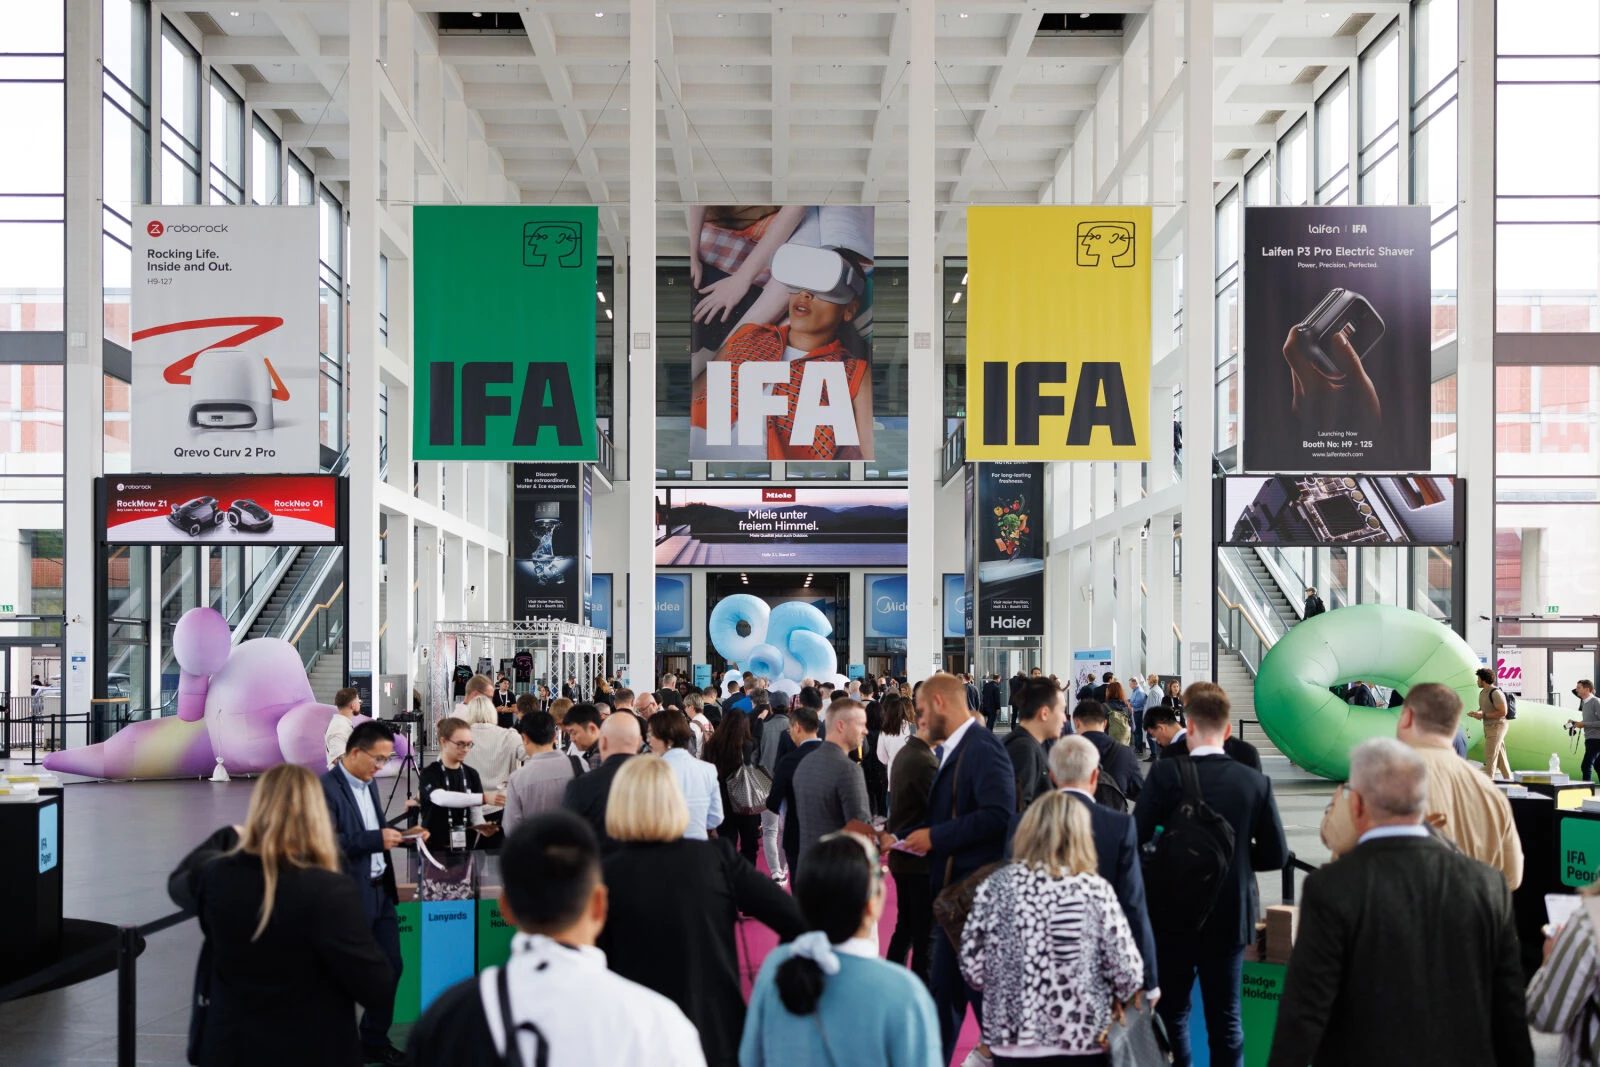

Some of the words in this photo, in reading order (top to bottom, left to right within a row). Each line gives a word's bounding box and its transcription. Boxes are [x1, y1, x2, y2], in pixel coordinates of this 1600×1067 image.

[167, 224, 228, 232] roborock
[1308, 224, 1340, 234] laifen
[1352, 224, 1368, 234] IFA
[148, 249, 192, 260] Rocking
[196, 249, 219, 258] Life.
[1262, 246, 1294, 256] Laifen
[1297, 247, 1310, 256] P3
[1314, 247, 1332, 256] Pro
[1336, 246, 1374, 256] Electric
[1378, 246, 1414, 256] Shaver
[148, 262, 180, 271] Inside
[184, 262, 205, 271] and
[208, 262, 232, 271] Out.
[430, 362, 584, 446] IFA
[706, 360, 860, 446] IFA
[983, 362, 1136, 446] IFA
[174, 447, 210, 458] Qrevo
[214, 447, 241, 458] Curv
[244, 448, 252, 457] 2
[255, 448, 276, 457] Pro
[748, 510, 777, 519] Miele
[780, 510, 808, 519] unter
[739, 521, 772, 530] freiem
[775, 521, 819, 530] Himmel.
[655, 602, 680, 611] idea
[991, 616, 1032, 628] Haier
[1567, 850, 1586, 865] IFA
[1567, 866, 1598, 882] Peop
[428, 912, 467, 922] Lanyards
[1243, 974, 1276, 989] Badge
